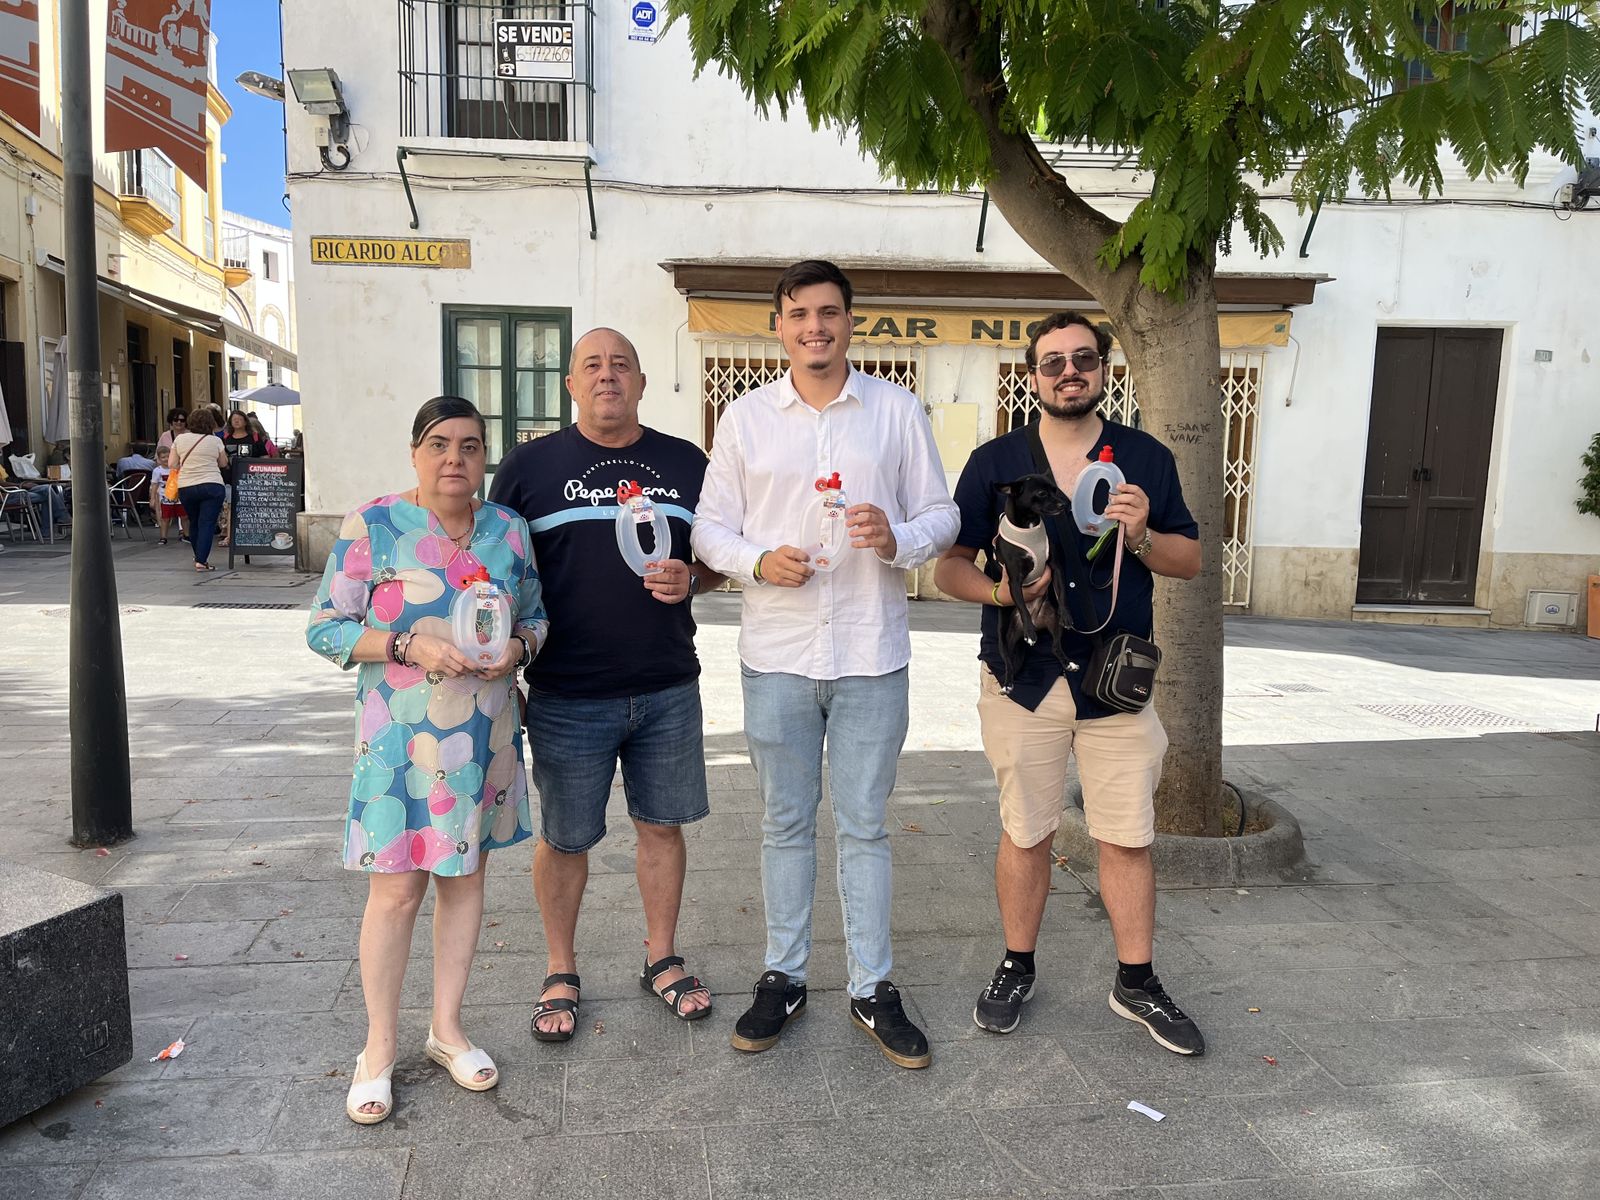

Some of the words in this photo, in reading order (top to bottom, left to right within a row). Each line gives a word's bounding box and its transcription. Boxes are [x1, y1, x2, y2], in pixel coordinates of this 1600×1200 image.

[636, 9, 653, 20] ADT
[498, 26, 518, 43] SE
[521, 26, 572, 44] VENDE
[317, 241, 396, 260] RICARDO
[516, 431, 528, 443] SE
[564, 479, 616, 506] Pepe
